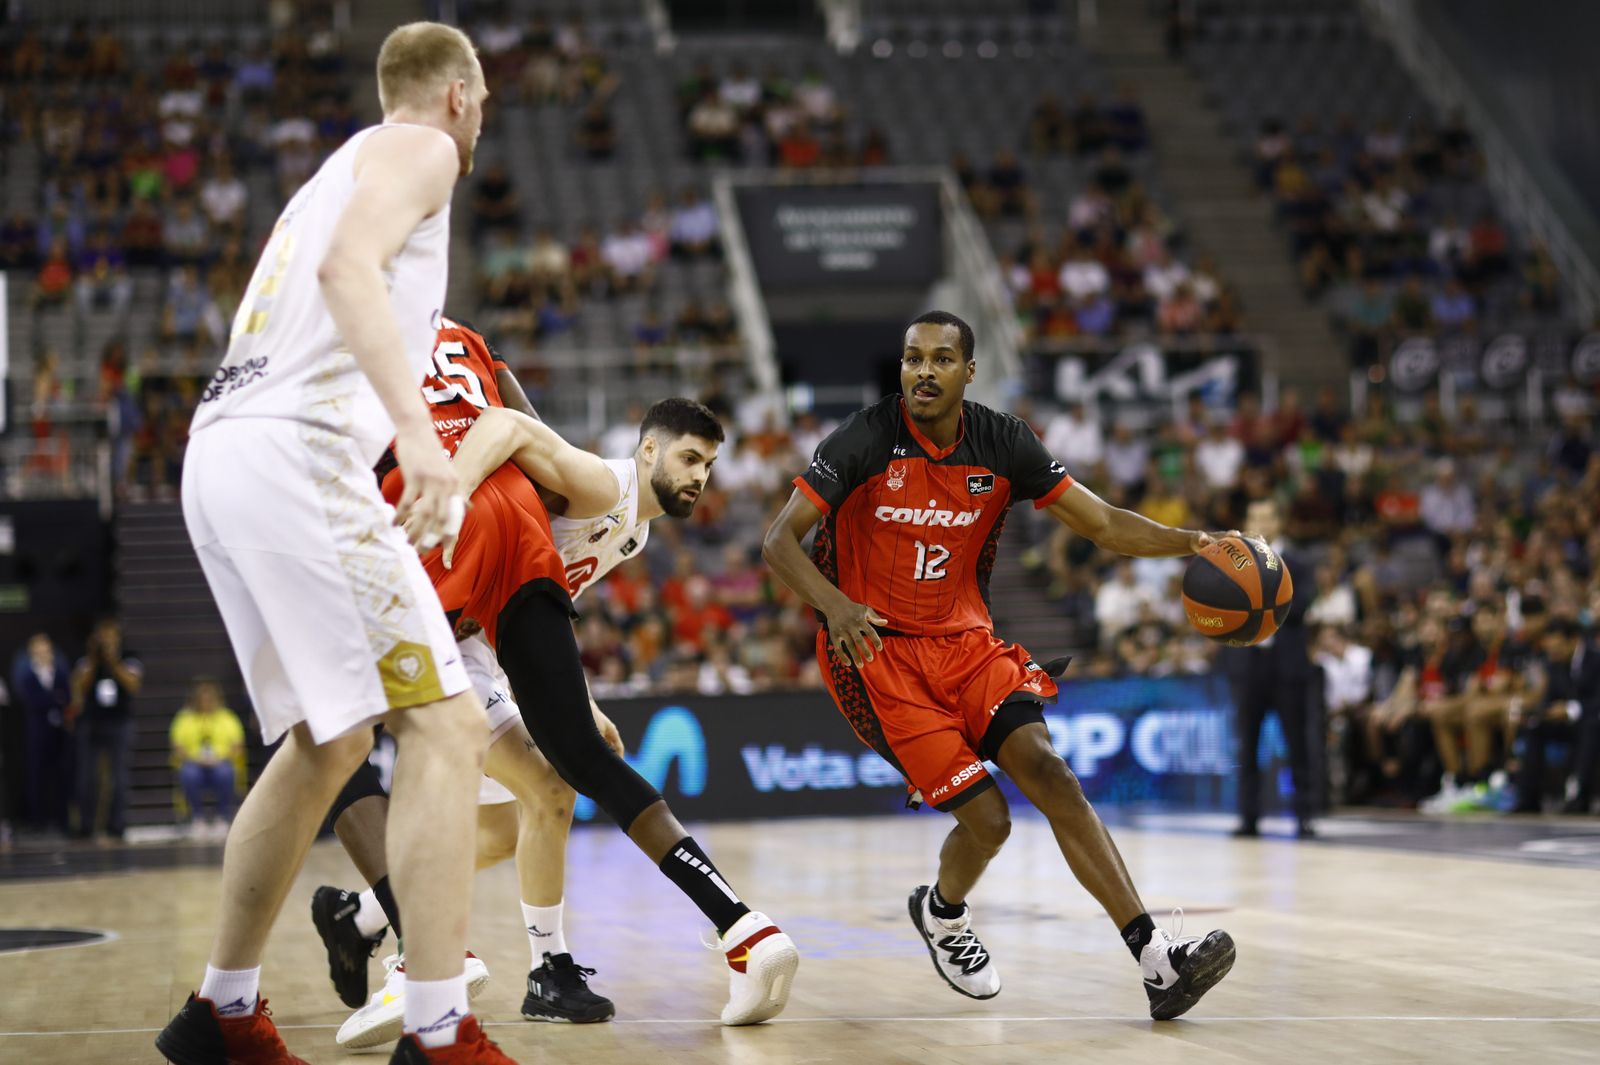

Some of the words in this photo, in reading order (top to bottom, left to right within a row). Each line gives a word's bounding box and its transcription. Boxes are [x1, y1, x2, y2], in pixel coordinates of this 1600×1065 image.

[914, 540, 951, 580] 12
[741, 744, 853, 791] Vota
[951, 760, 983, 787] asisa
